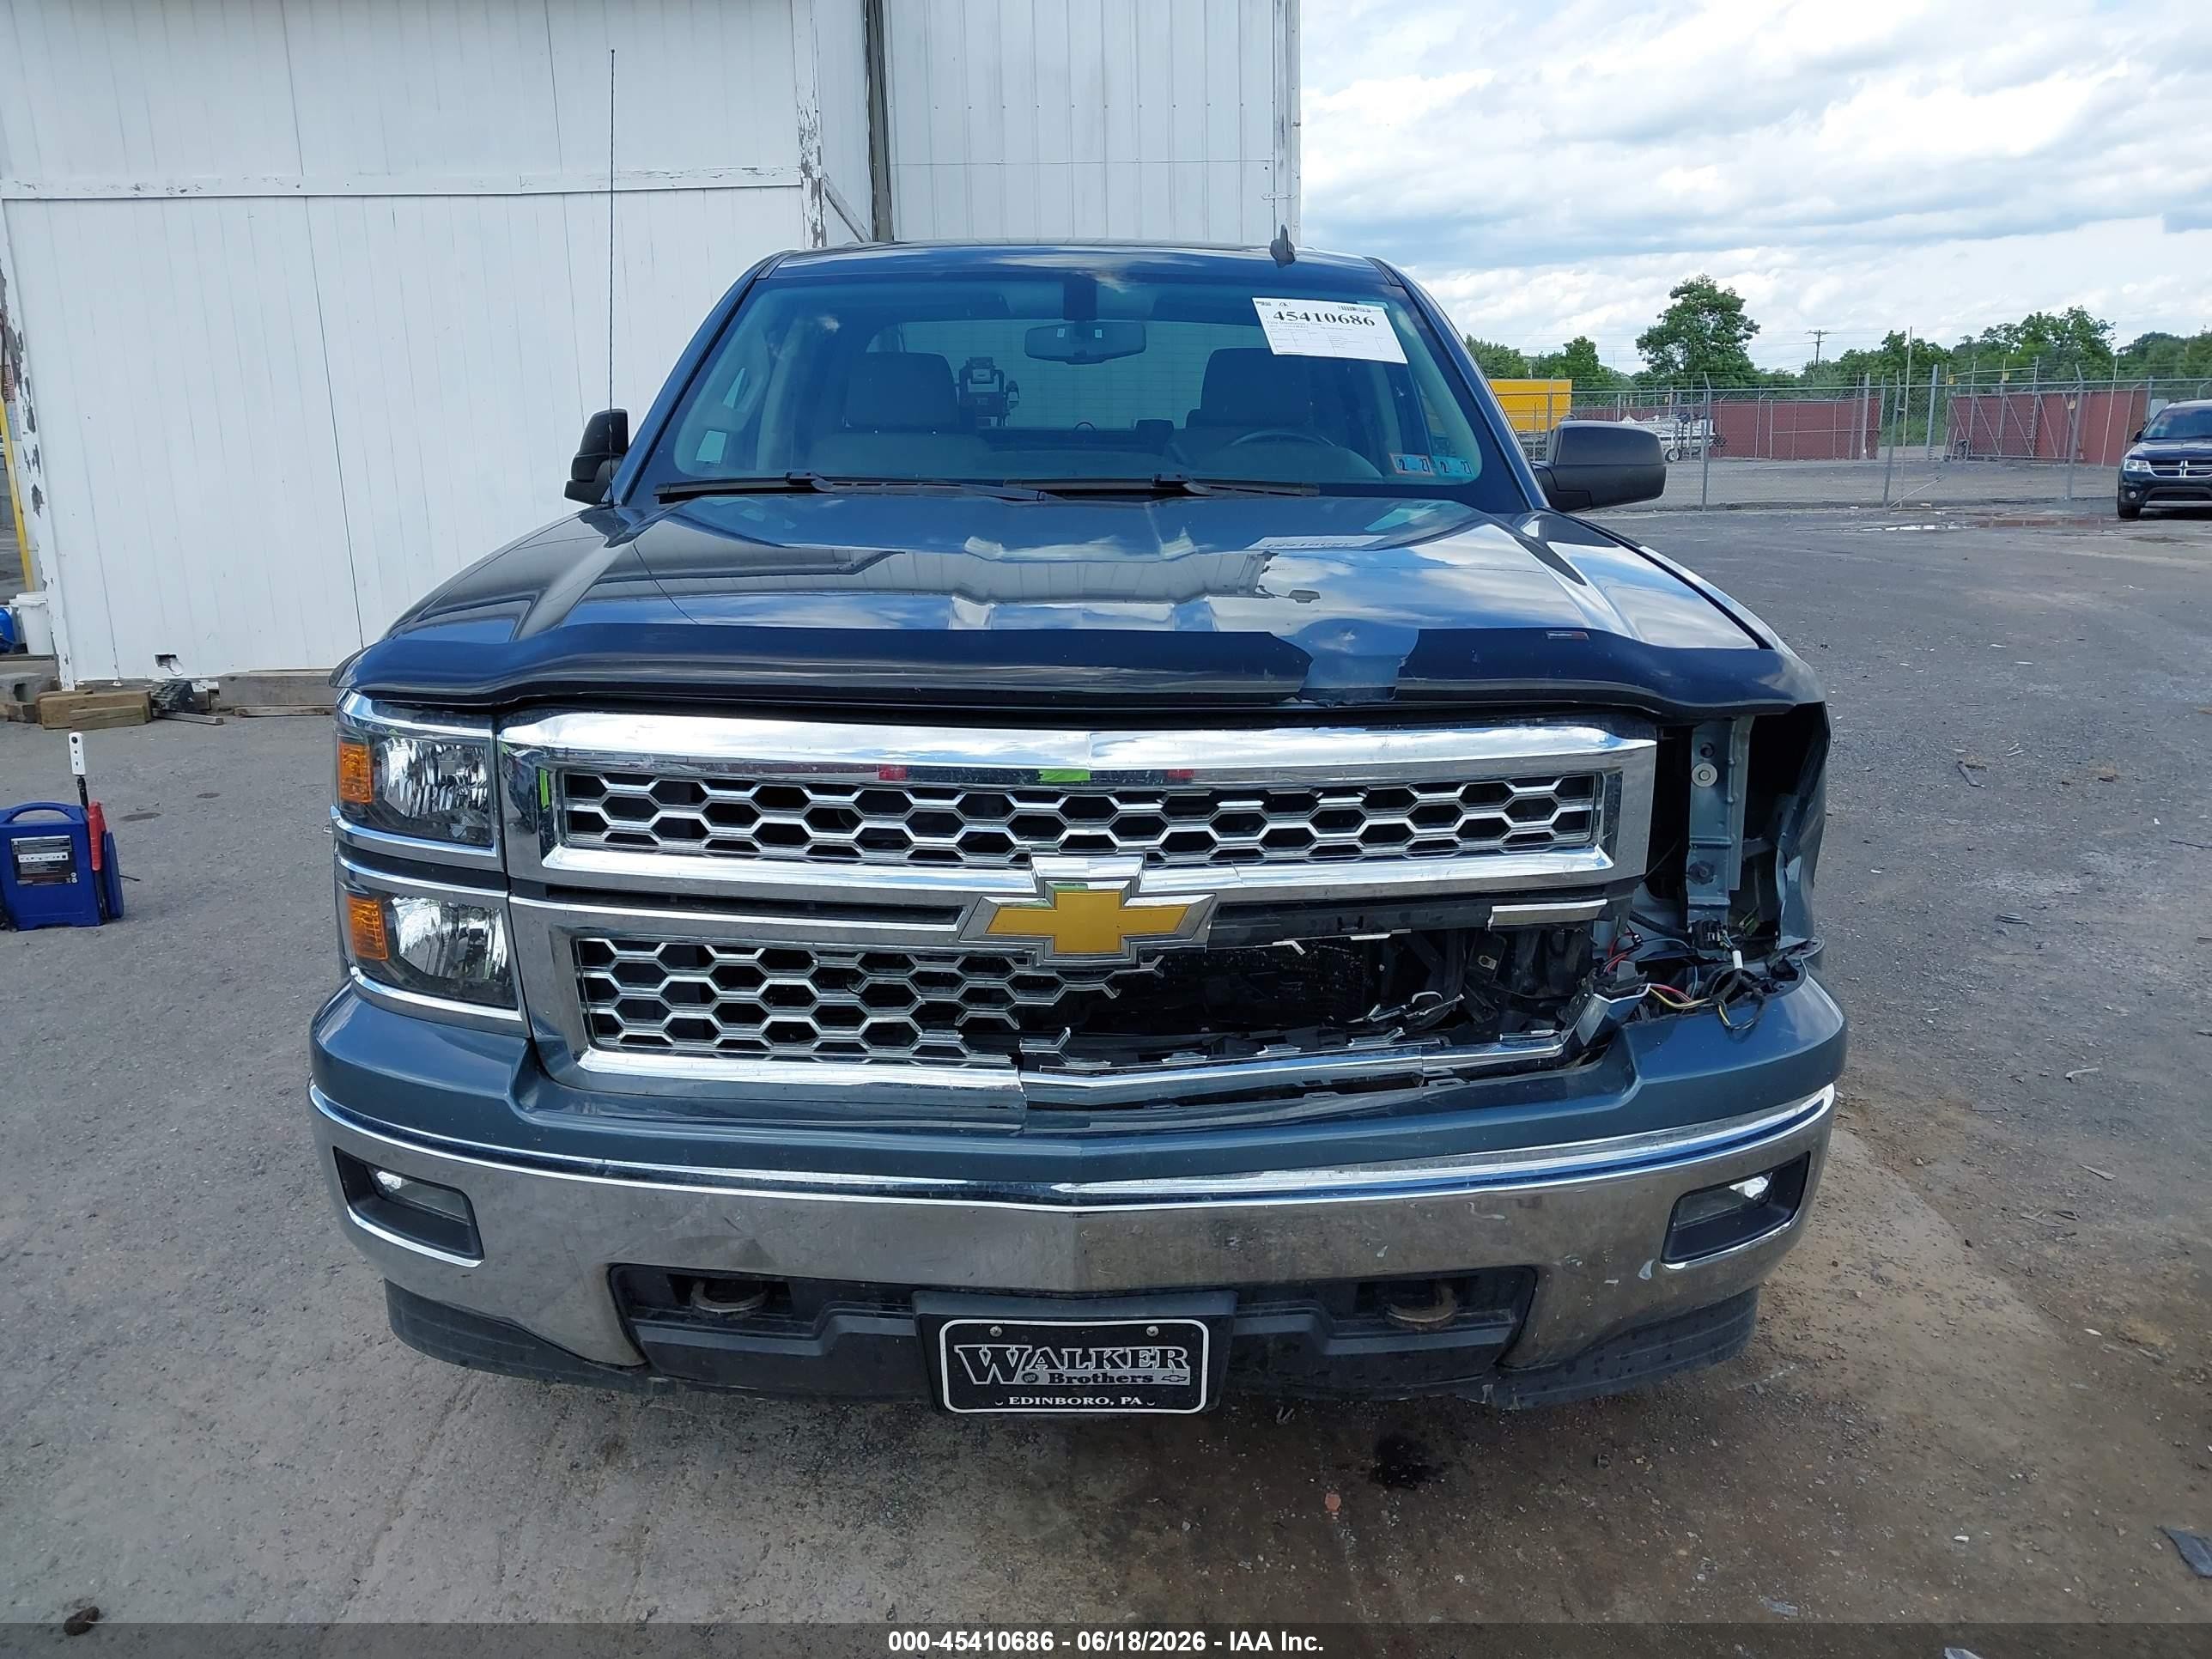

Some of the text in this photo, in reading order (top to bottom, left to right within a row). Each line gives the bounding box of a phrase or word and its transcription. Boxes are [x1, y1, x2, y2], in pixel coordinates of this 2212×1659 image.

[1273, 310, 1376, 327] 45410686
[954, 1344, 1190, 1385] WALKER
[1048, 1372, 1154, 1384] Brothers
[1008, 1396, 1143, 1406] EDINBORO, PA
